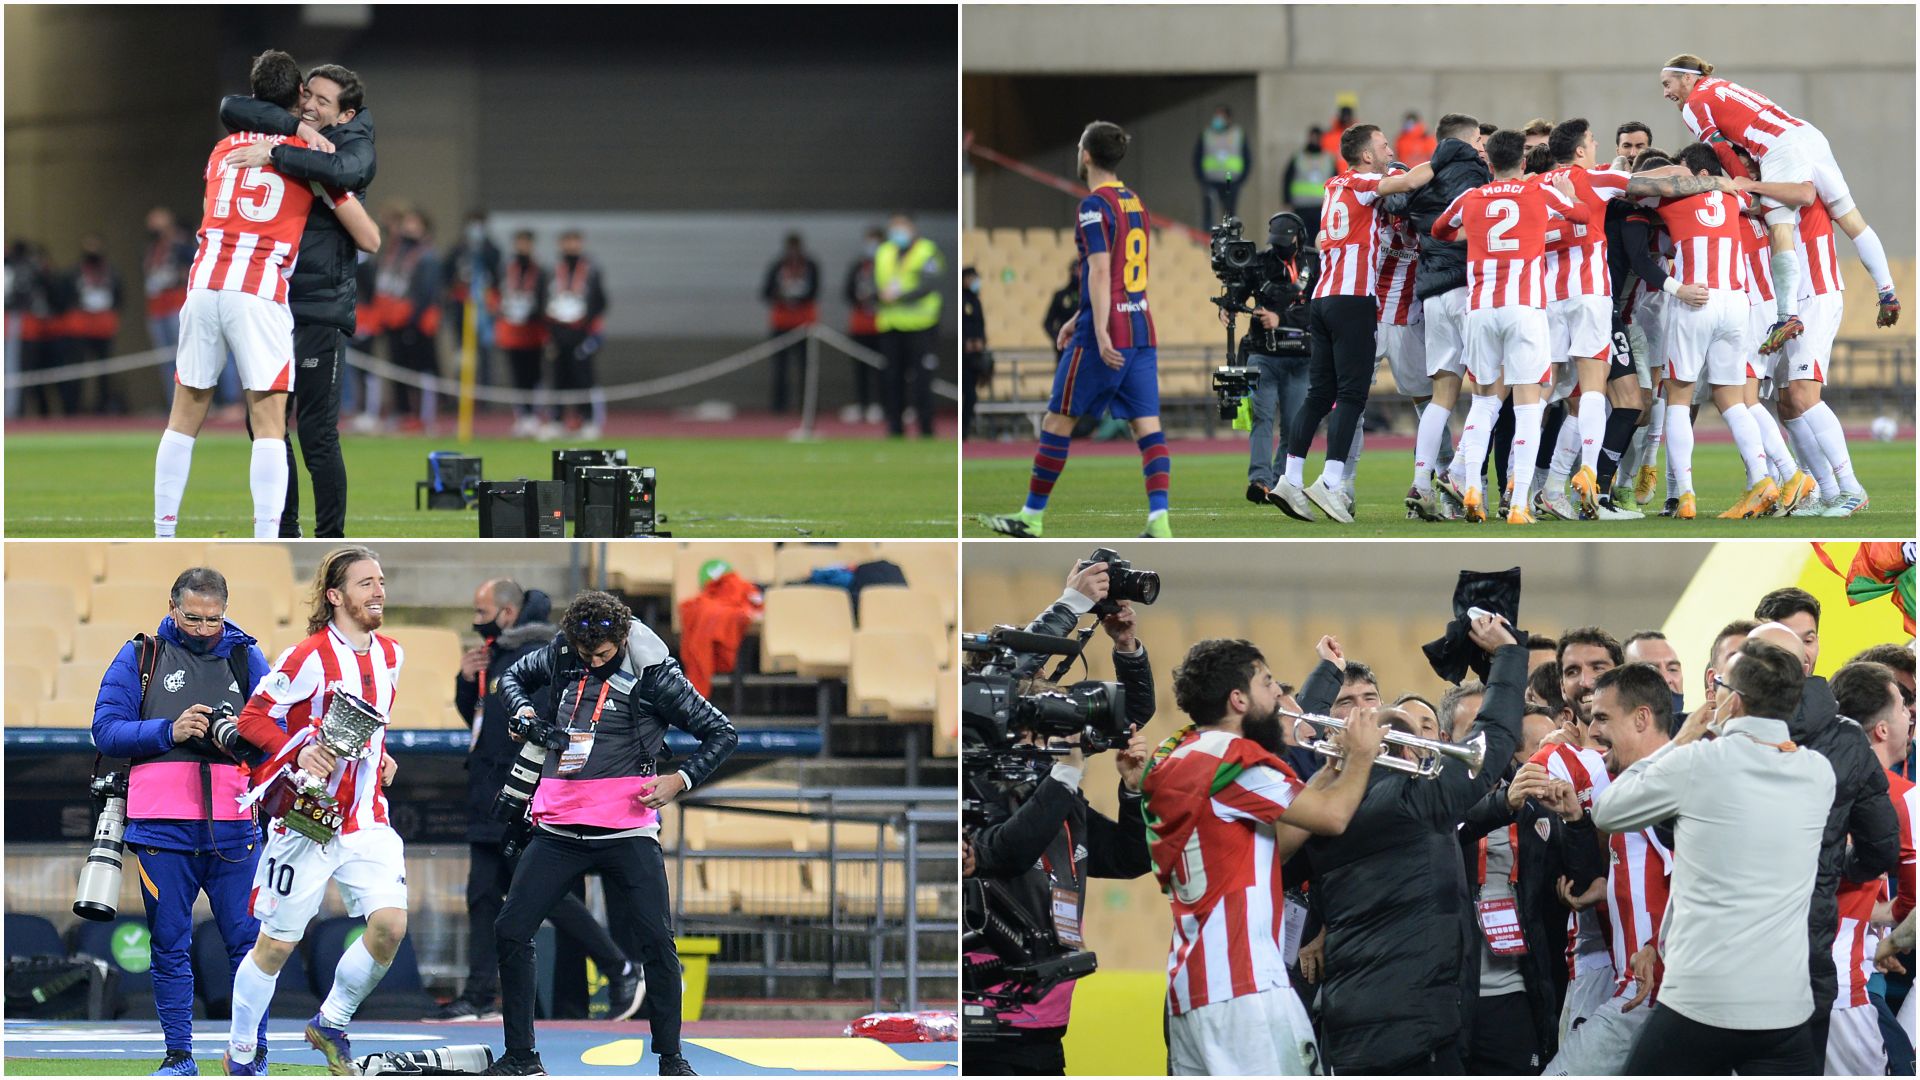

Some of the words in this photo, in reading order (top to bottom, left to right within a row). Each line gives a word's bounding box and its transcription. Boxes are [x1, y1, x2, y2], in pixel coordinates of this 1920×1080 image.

[213, 158, 285, 222] 15
[1320, 186, 1350, 241] 26
[1695, 190, 1726, 228] 3
[1485, 198, 1520, 252] 2
[1123, 227, 1147, 293] 8
[267, 857, 295, 897] 10
